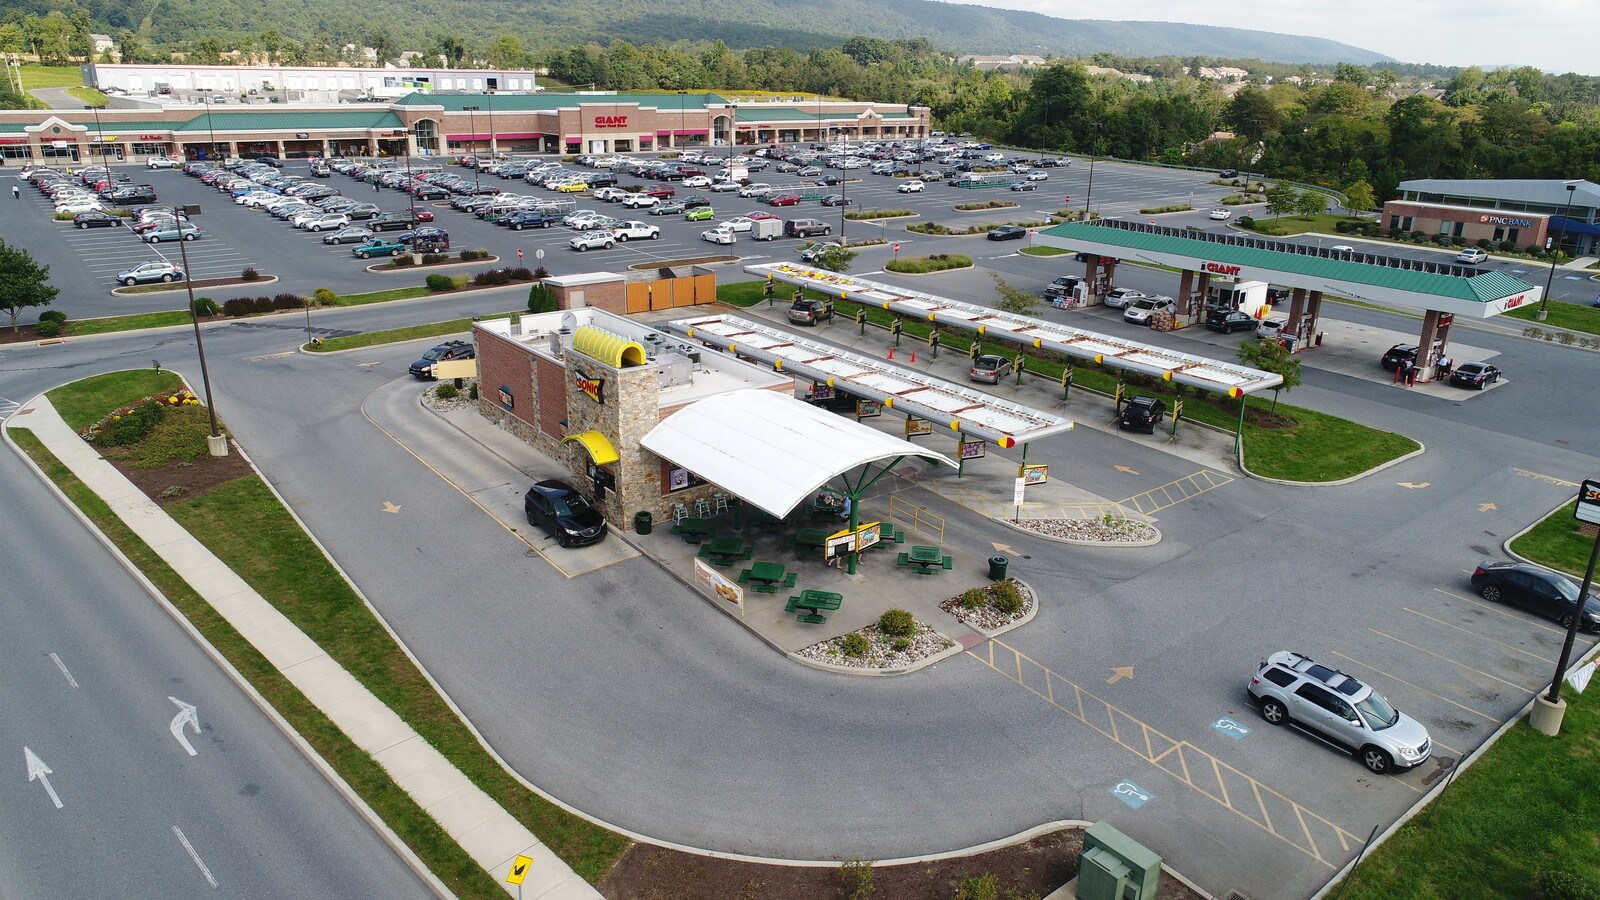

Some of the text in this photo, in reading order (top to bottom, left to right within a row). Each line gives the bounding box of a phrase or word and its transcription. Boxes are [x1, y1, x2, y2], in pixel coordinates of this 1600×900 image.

[1489, 216, 1532, 228] PNC BANK
[1207, 262, 1241, 276] GIANT
[577, 378, 598, 396] SONIC
